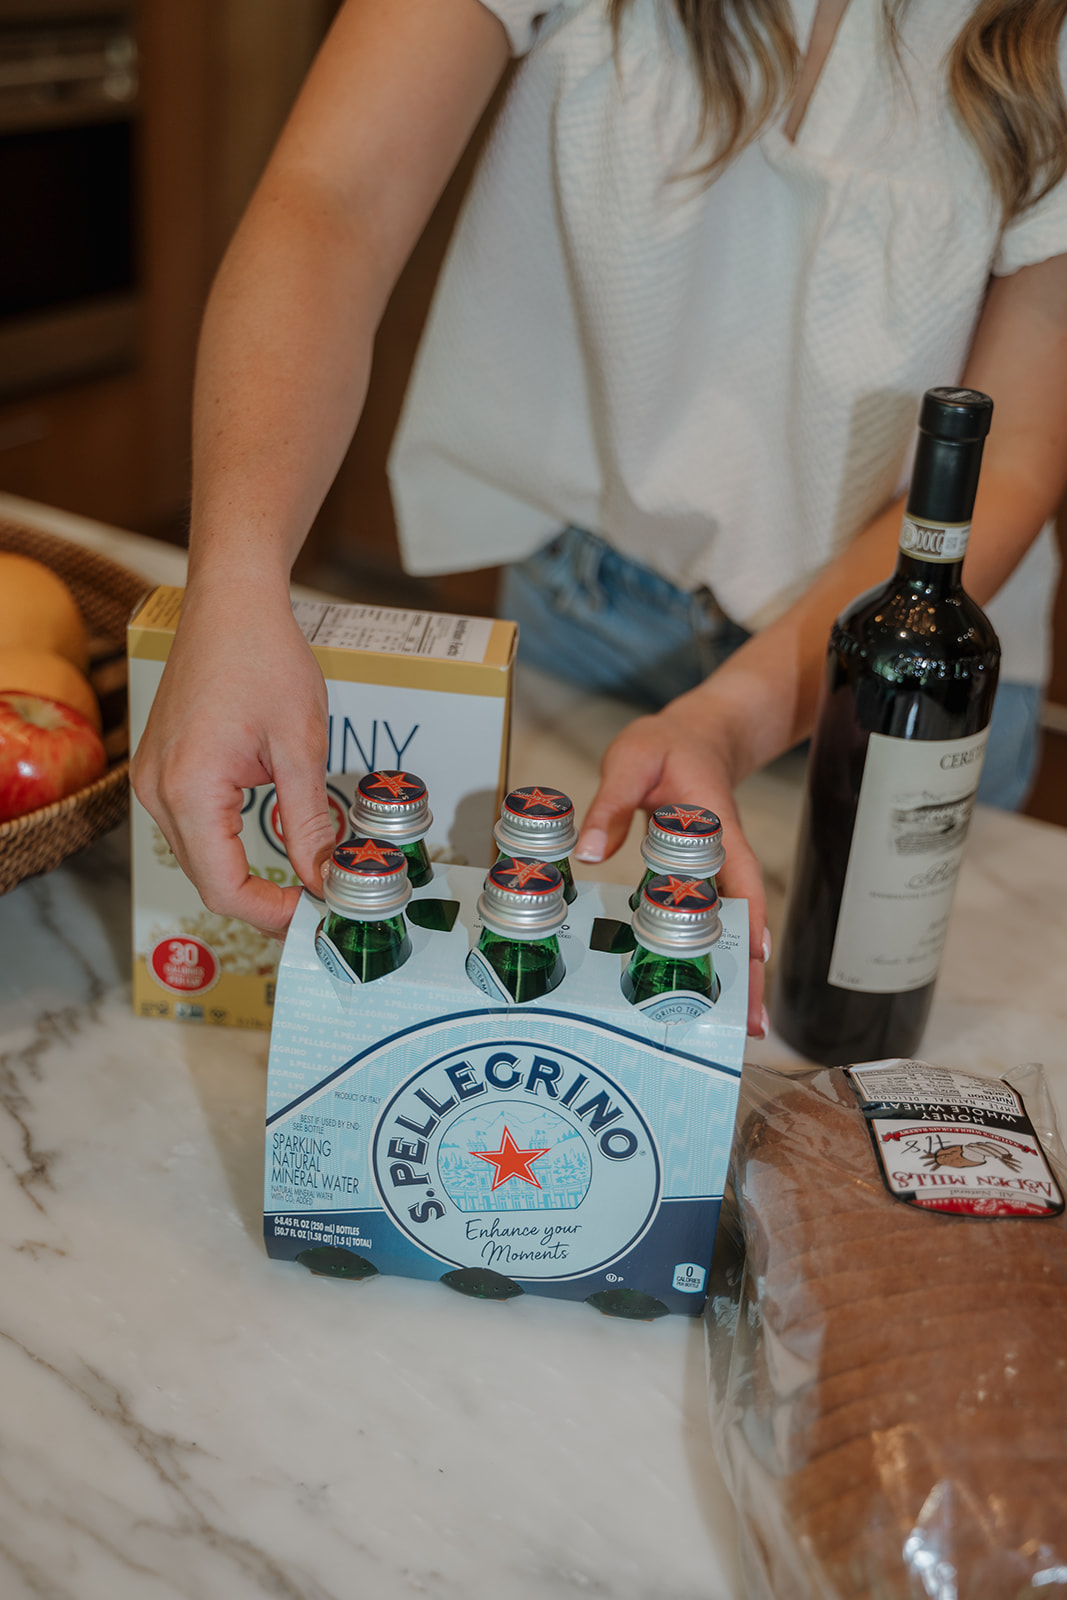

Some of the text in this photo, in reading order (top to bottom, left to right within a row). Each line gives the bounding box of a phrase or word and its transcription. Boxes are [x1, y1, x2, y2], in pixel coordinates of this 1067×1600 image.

[168, 941, 199, 967] 30
[334, 1091, 359, 1102] PRODUCT
[360, 1094, 367, 1102] OF
[934, 1098, 977, 1106] NATURAL
[967, 1093, 1014, 1106] Nutrition
[881, 1102, 1017, 1123] WHOLE WHEAT
[990, 1102, 1021, 1116] SIMPLE
[300, 1114, 314, 1123] BEST
[320, 1116, 337, 1127] USED
[337, 1120, 345, 1128] BY
[921, 1112, 985, 1125] HONEY
[292, 1122, 325, 1135] SEE BOTTLE
[952, 1127, 982, 1136] WHOLE
[272, 1132, 332, 1157] SPARKLING
[387, 1051, 639, 1225] S.PELLEGRINO
[272, 1151, 321, 1173] NATURAL
[271, 1167, 360, 1195] MINERAL WATER
[892, 1171, 1052, 1198] ASPEN MILLS
[271, 1185, 294, 1194] NATURAL
[316, 1192, 334, 1201] WATER
[950, 1189, 991, 1197] Natural
[293, 1218, 300, 1228] FL
[300, 1219, 310, 1229] OZ
[310, 1221, 324, 1232] (250
[336, 1225, 360, 1236] BOTTLES
[465, 1217, 583, 1246] Enhance your
[274, 1226, 289, 1237] (50.7
[290, 1229, 297, 1238] FL
[297, 1230, 307, 1239] OZ
[352, 1237, 373, 1249] TOTAL)
[481, 1240, 570, 1267] Moments
[676, 1275, 701, 1284] CALORIES
[686, 1266, 694, 1278] 0
